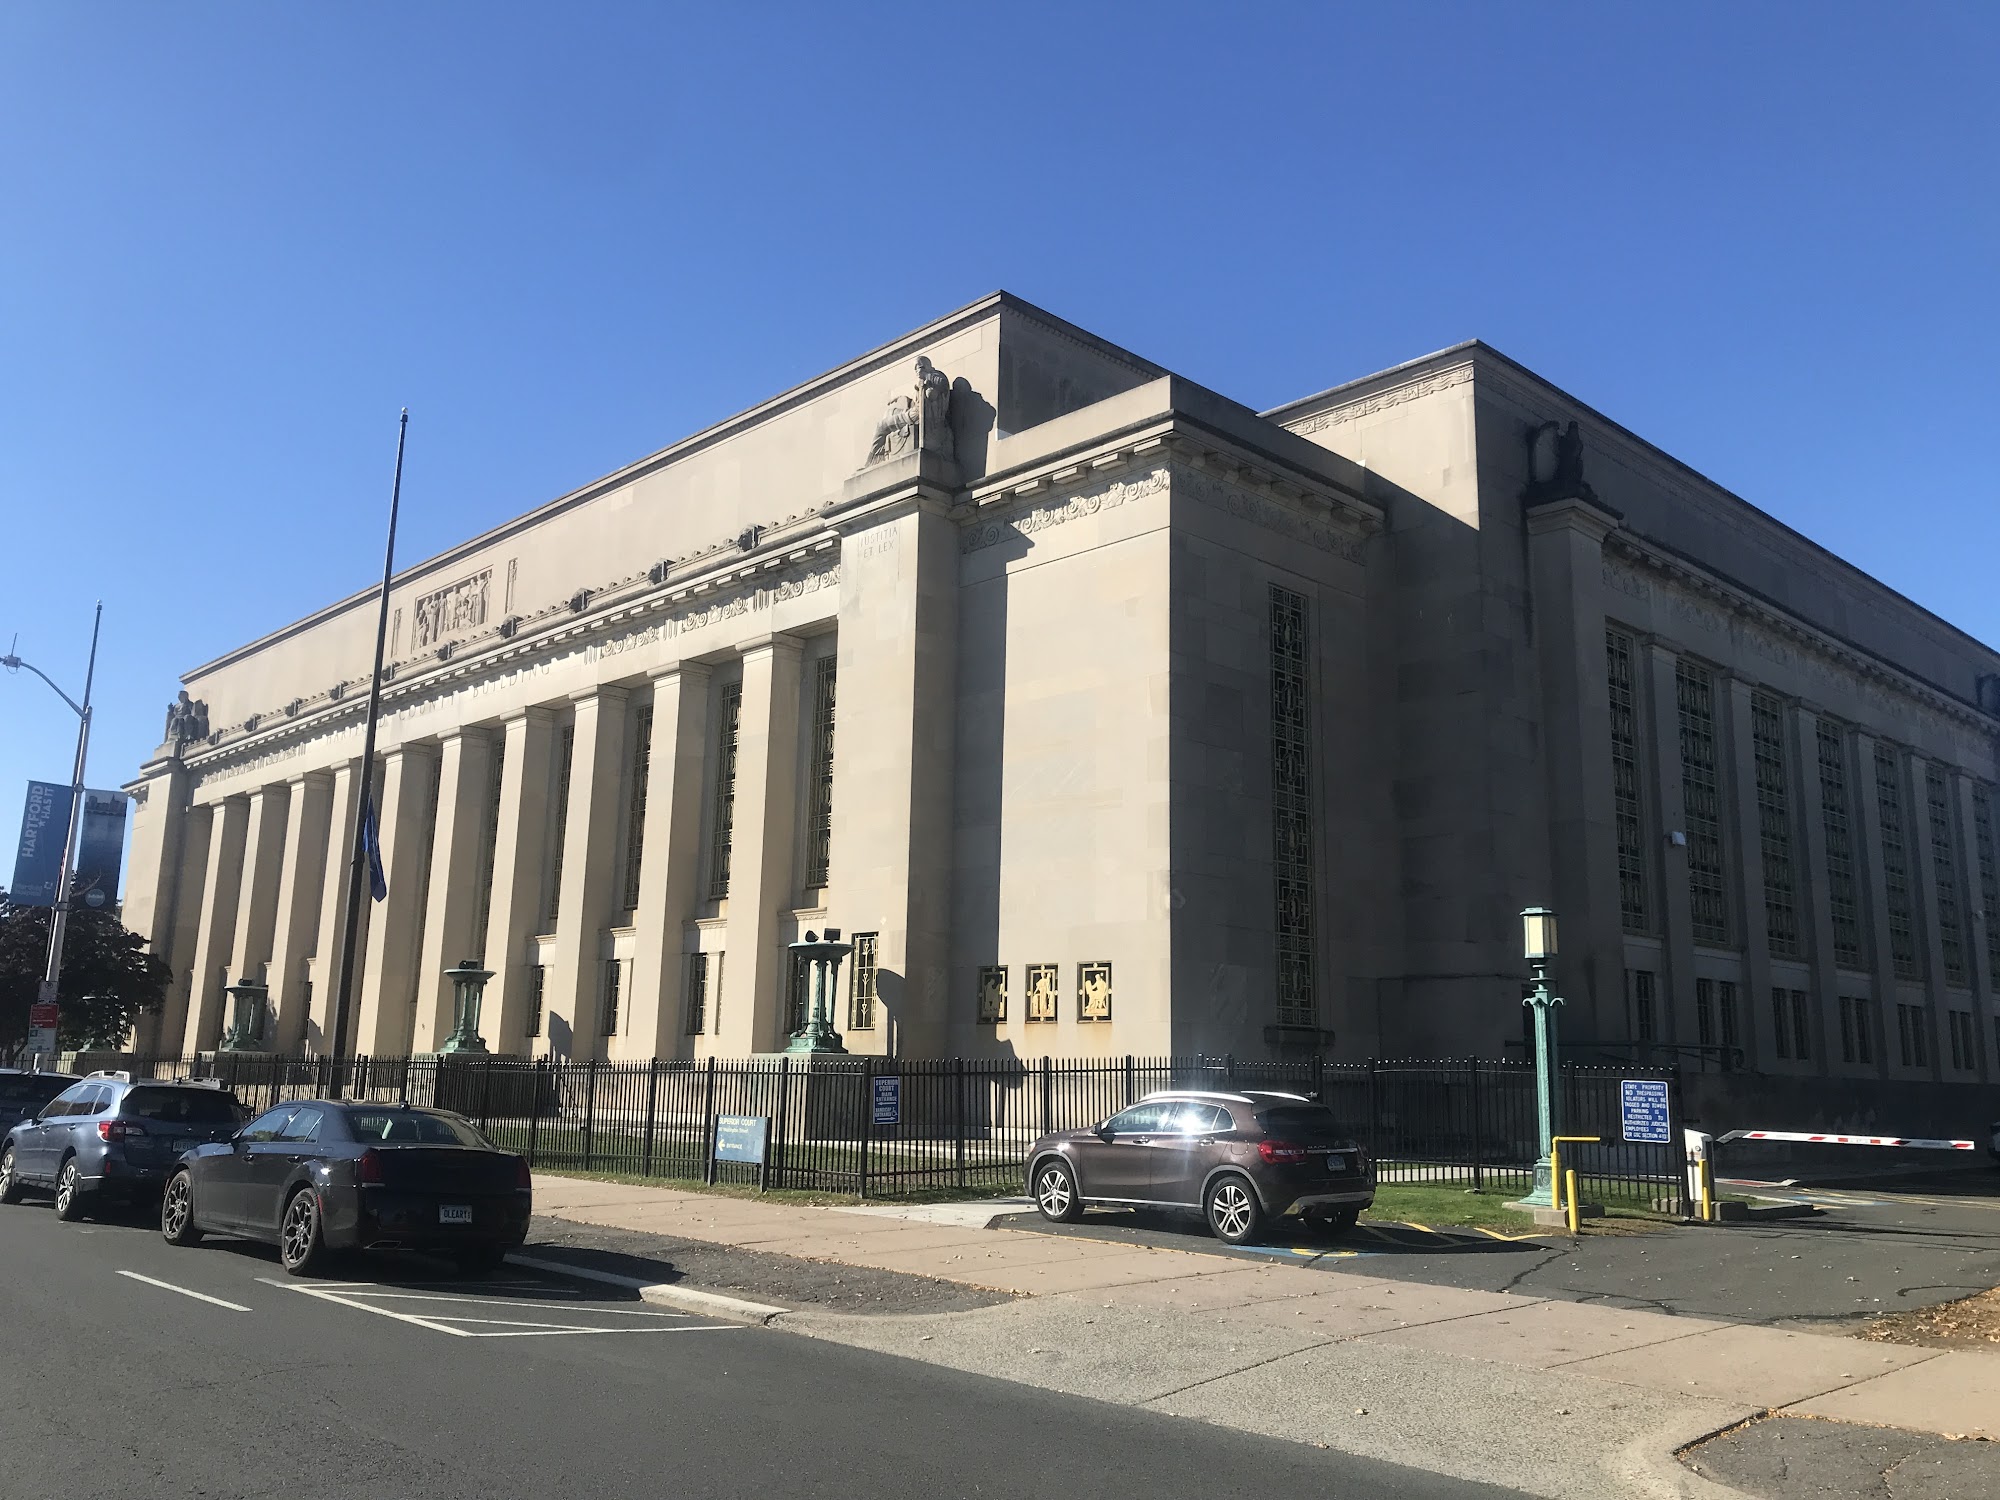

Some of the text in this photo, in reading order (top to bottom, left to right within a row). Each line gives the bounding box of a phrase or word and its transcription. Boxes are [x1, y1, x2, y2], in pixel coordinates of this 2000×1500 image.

[879, 540, 895, 554] LEX
[40, 787, 55, 819] HAS IT
[22, 785, 43, 858] HARTFORD
[718, 1117, 757, 1127] SUPERIOR COURT
